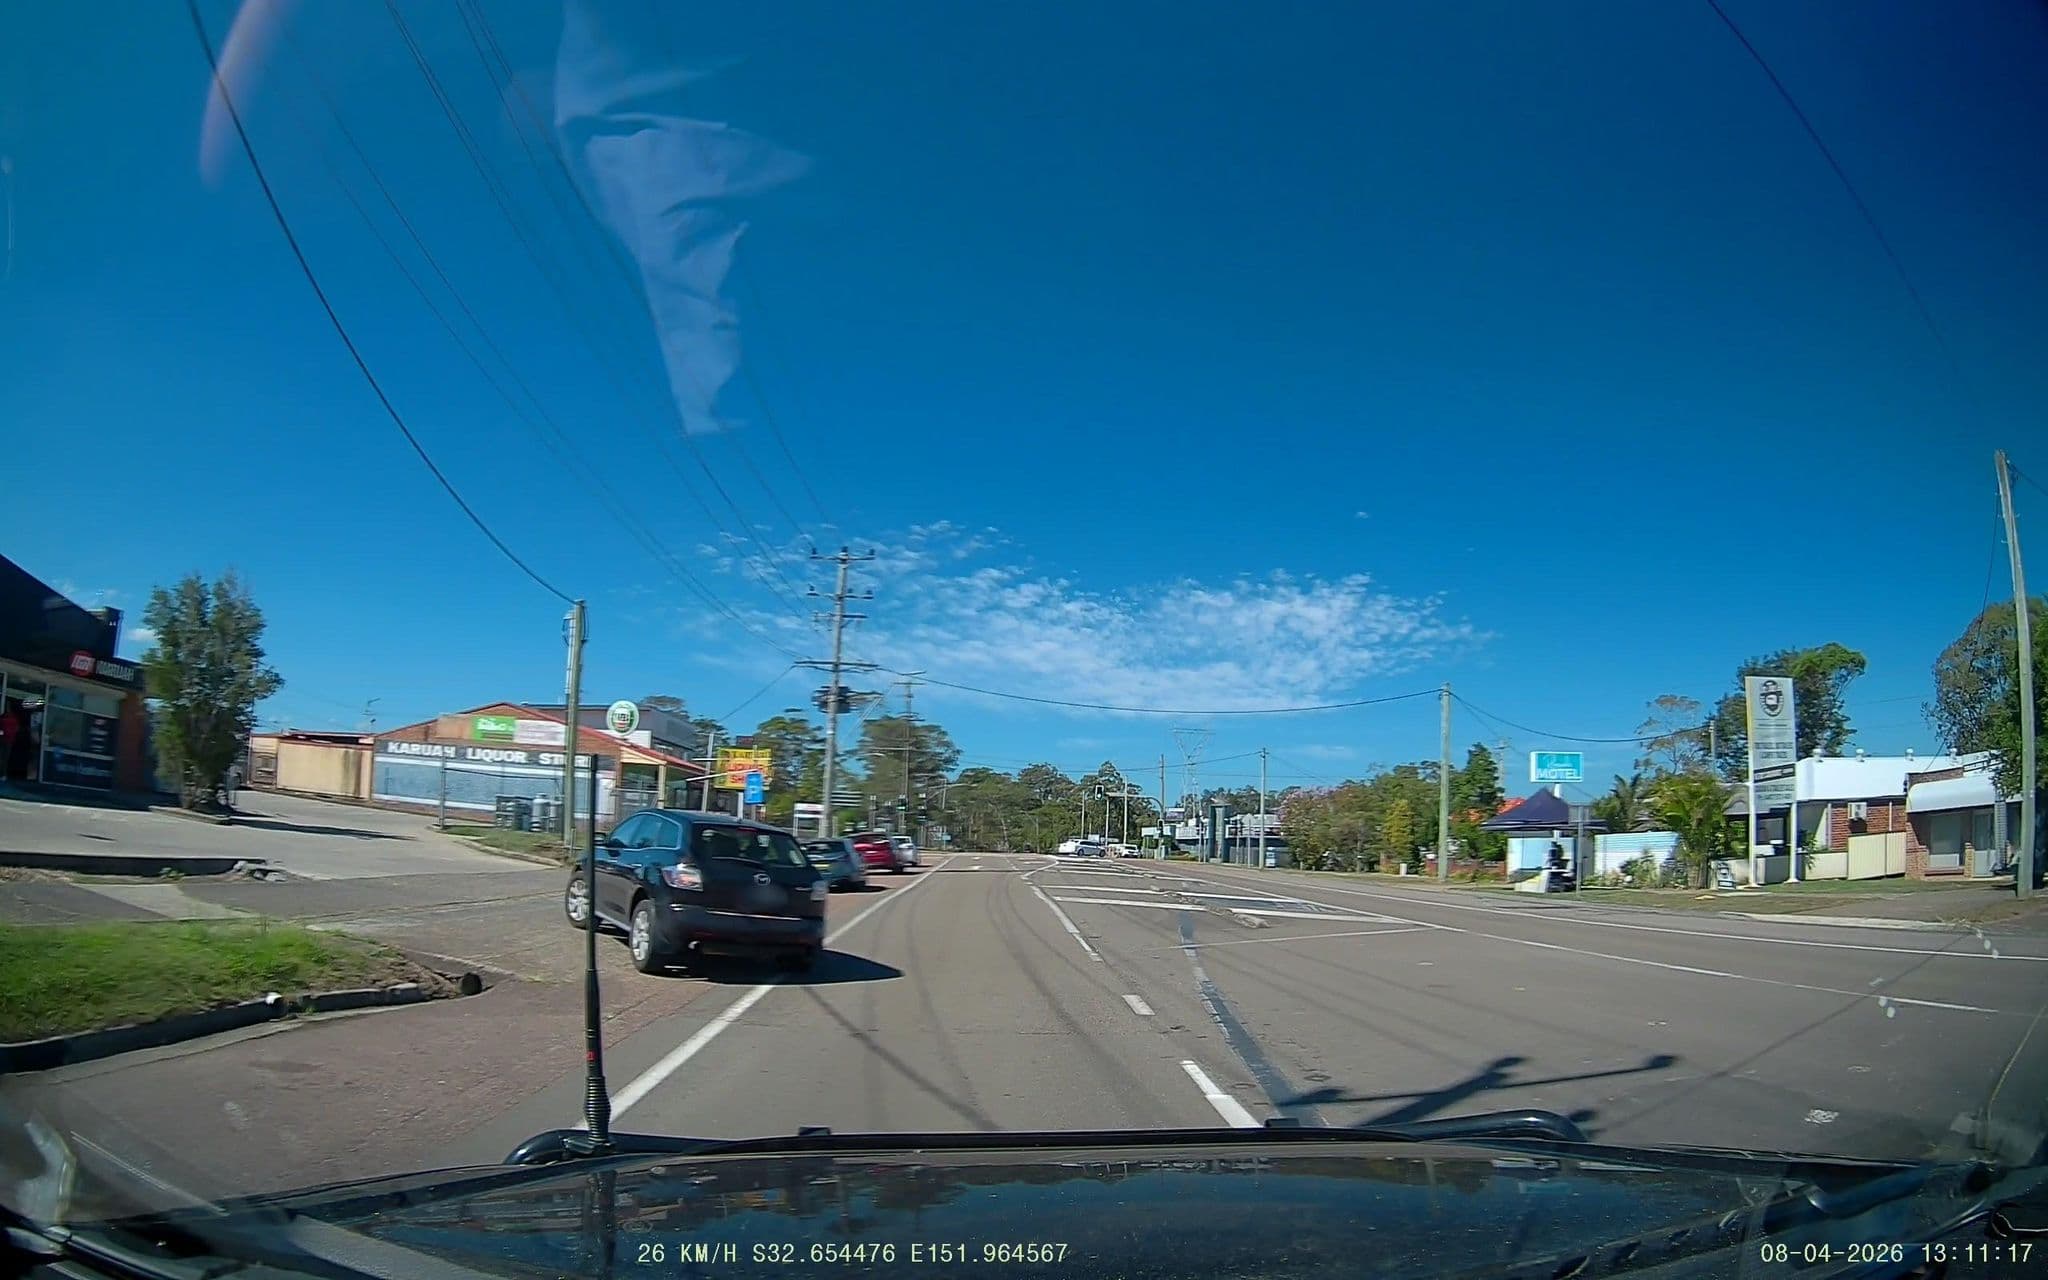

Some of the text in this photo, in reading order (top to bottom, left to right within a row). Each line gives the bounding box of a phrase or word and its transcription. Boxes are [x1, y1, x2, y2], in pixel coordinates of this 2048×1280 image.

[387, 742, 456, 758] KARUAH
[465, 747, 528, 764] LIQUOR
[1536, 768, 1582, 779] MOTEL
